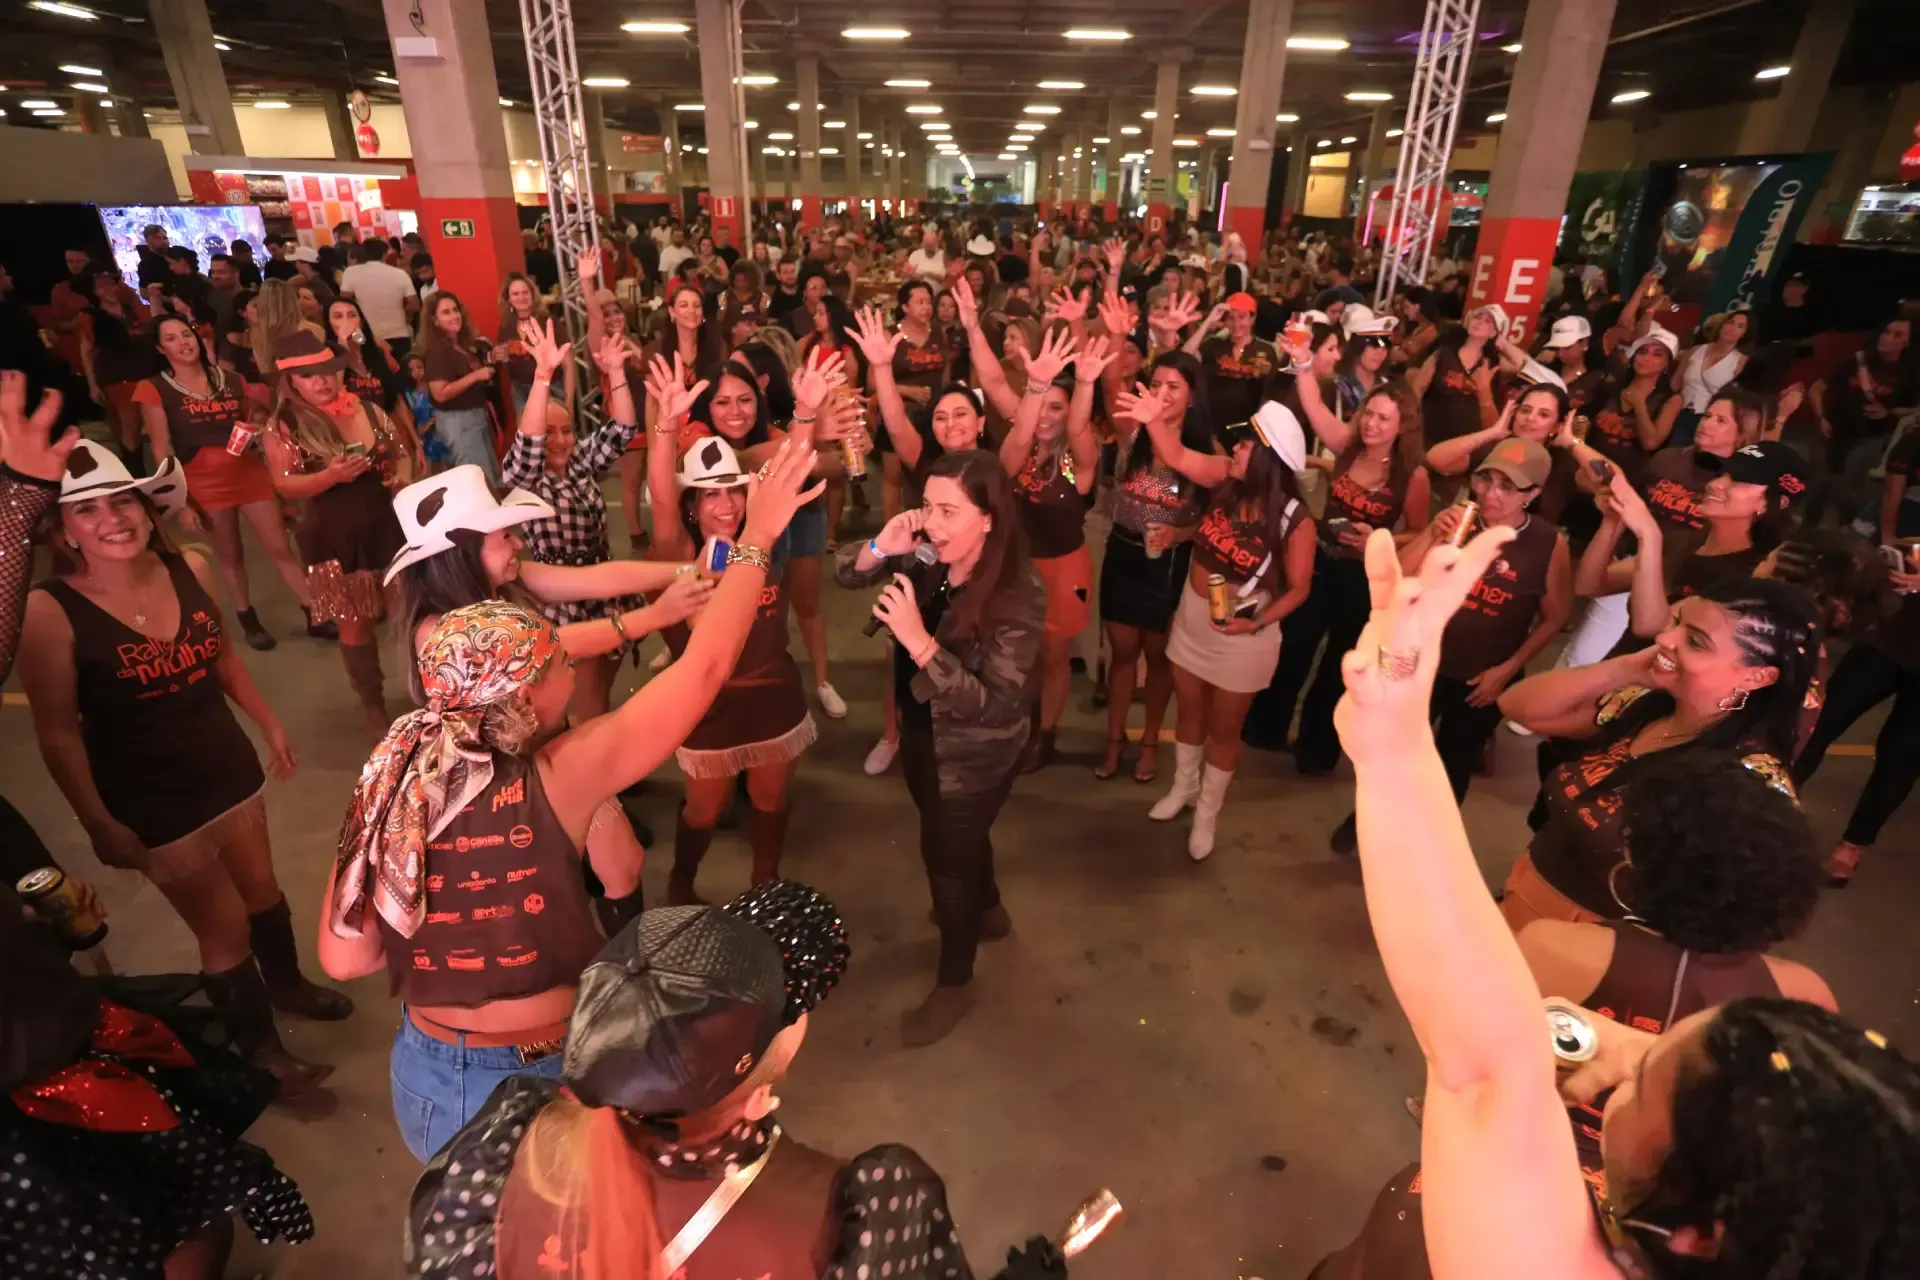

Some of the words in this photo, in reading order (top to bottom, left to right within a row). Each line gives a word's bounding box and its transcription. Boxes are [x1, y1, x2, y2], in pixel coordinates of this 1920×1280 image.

[1150, 216, 1162, 232] D
[1472, 255, 1494, 299] E
[1504, 259, 1539, 303] E
[116, 634, 175, 667] Rally
[117, 668, 136, 679] da
